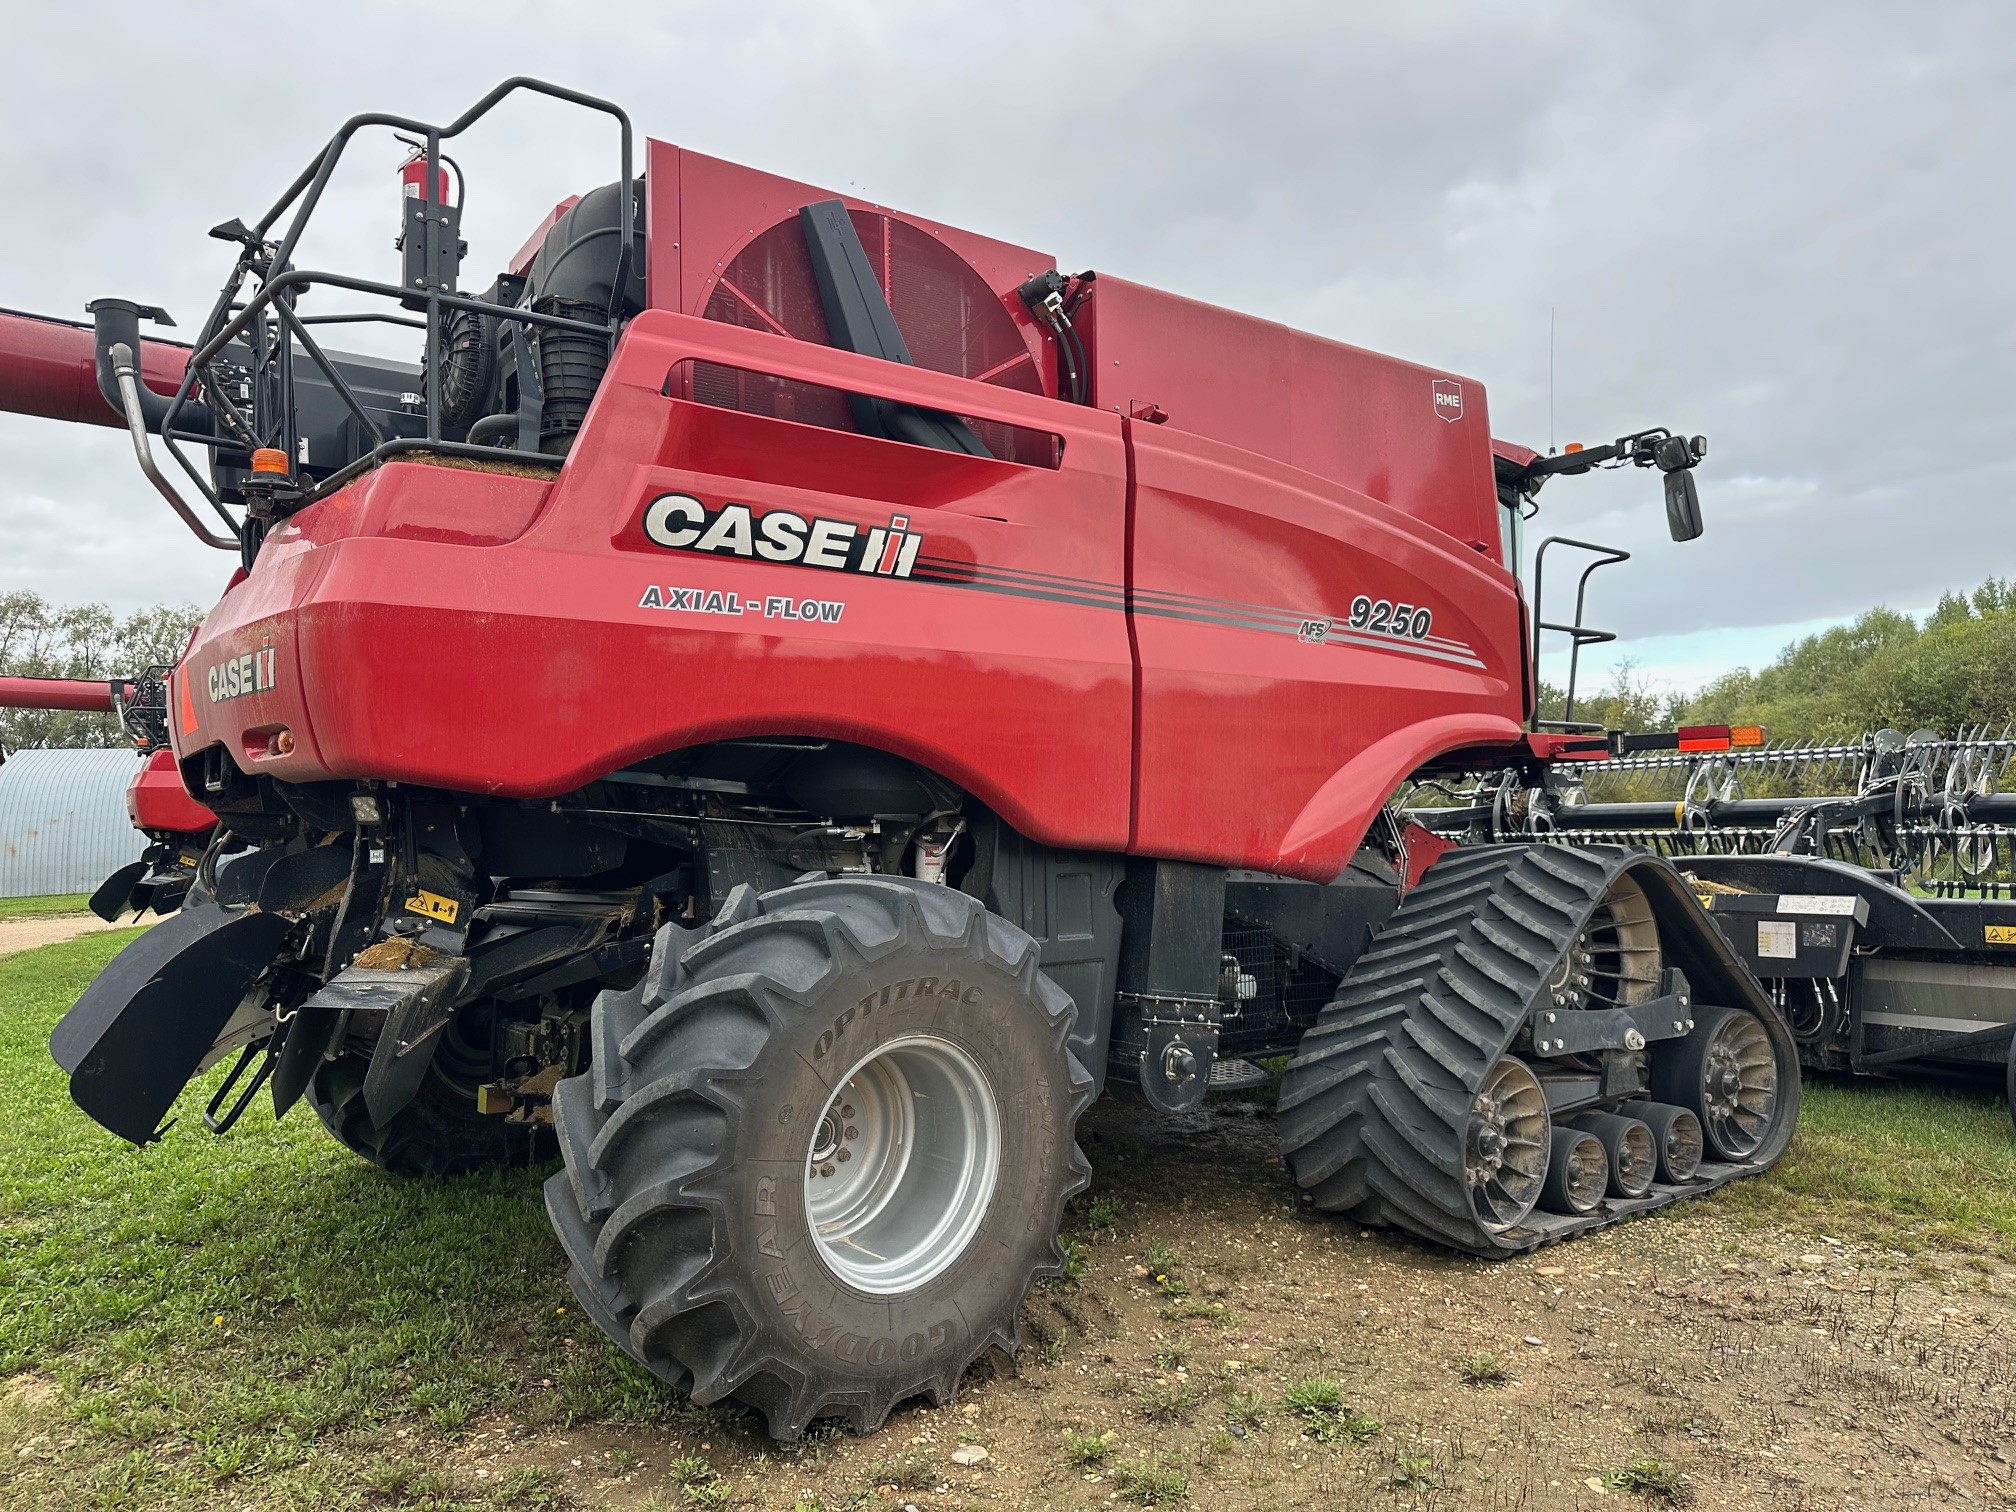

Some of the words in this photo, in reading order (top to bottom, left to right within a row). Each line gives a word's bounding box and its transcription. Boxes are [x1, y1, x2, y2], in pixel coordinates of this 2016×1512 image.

[1435, 392, 1461, 408] RME
[645, 494, 858, 569] CASE
[638, 585, 845, 623] AXIAL-FLOW
[1349, 595, 1432, 640] 9250
[1299, 619, 1328, 637] AFS
[208, 653, 254, 703] CASE
[813, 975, 985, 1061] OPTITRAC
[754, 1175, 957, 1367] GOODYEAR
